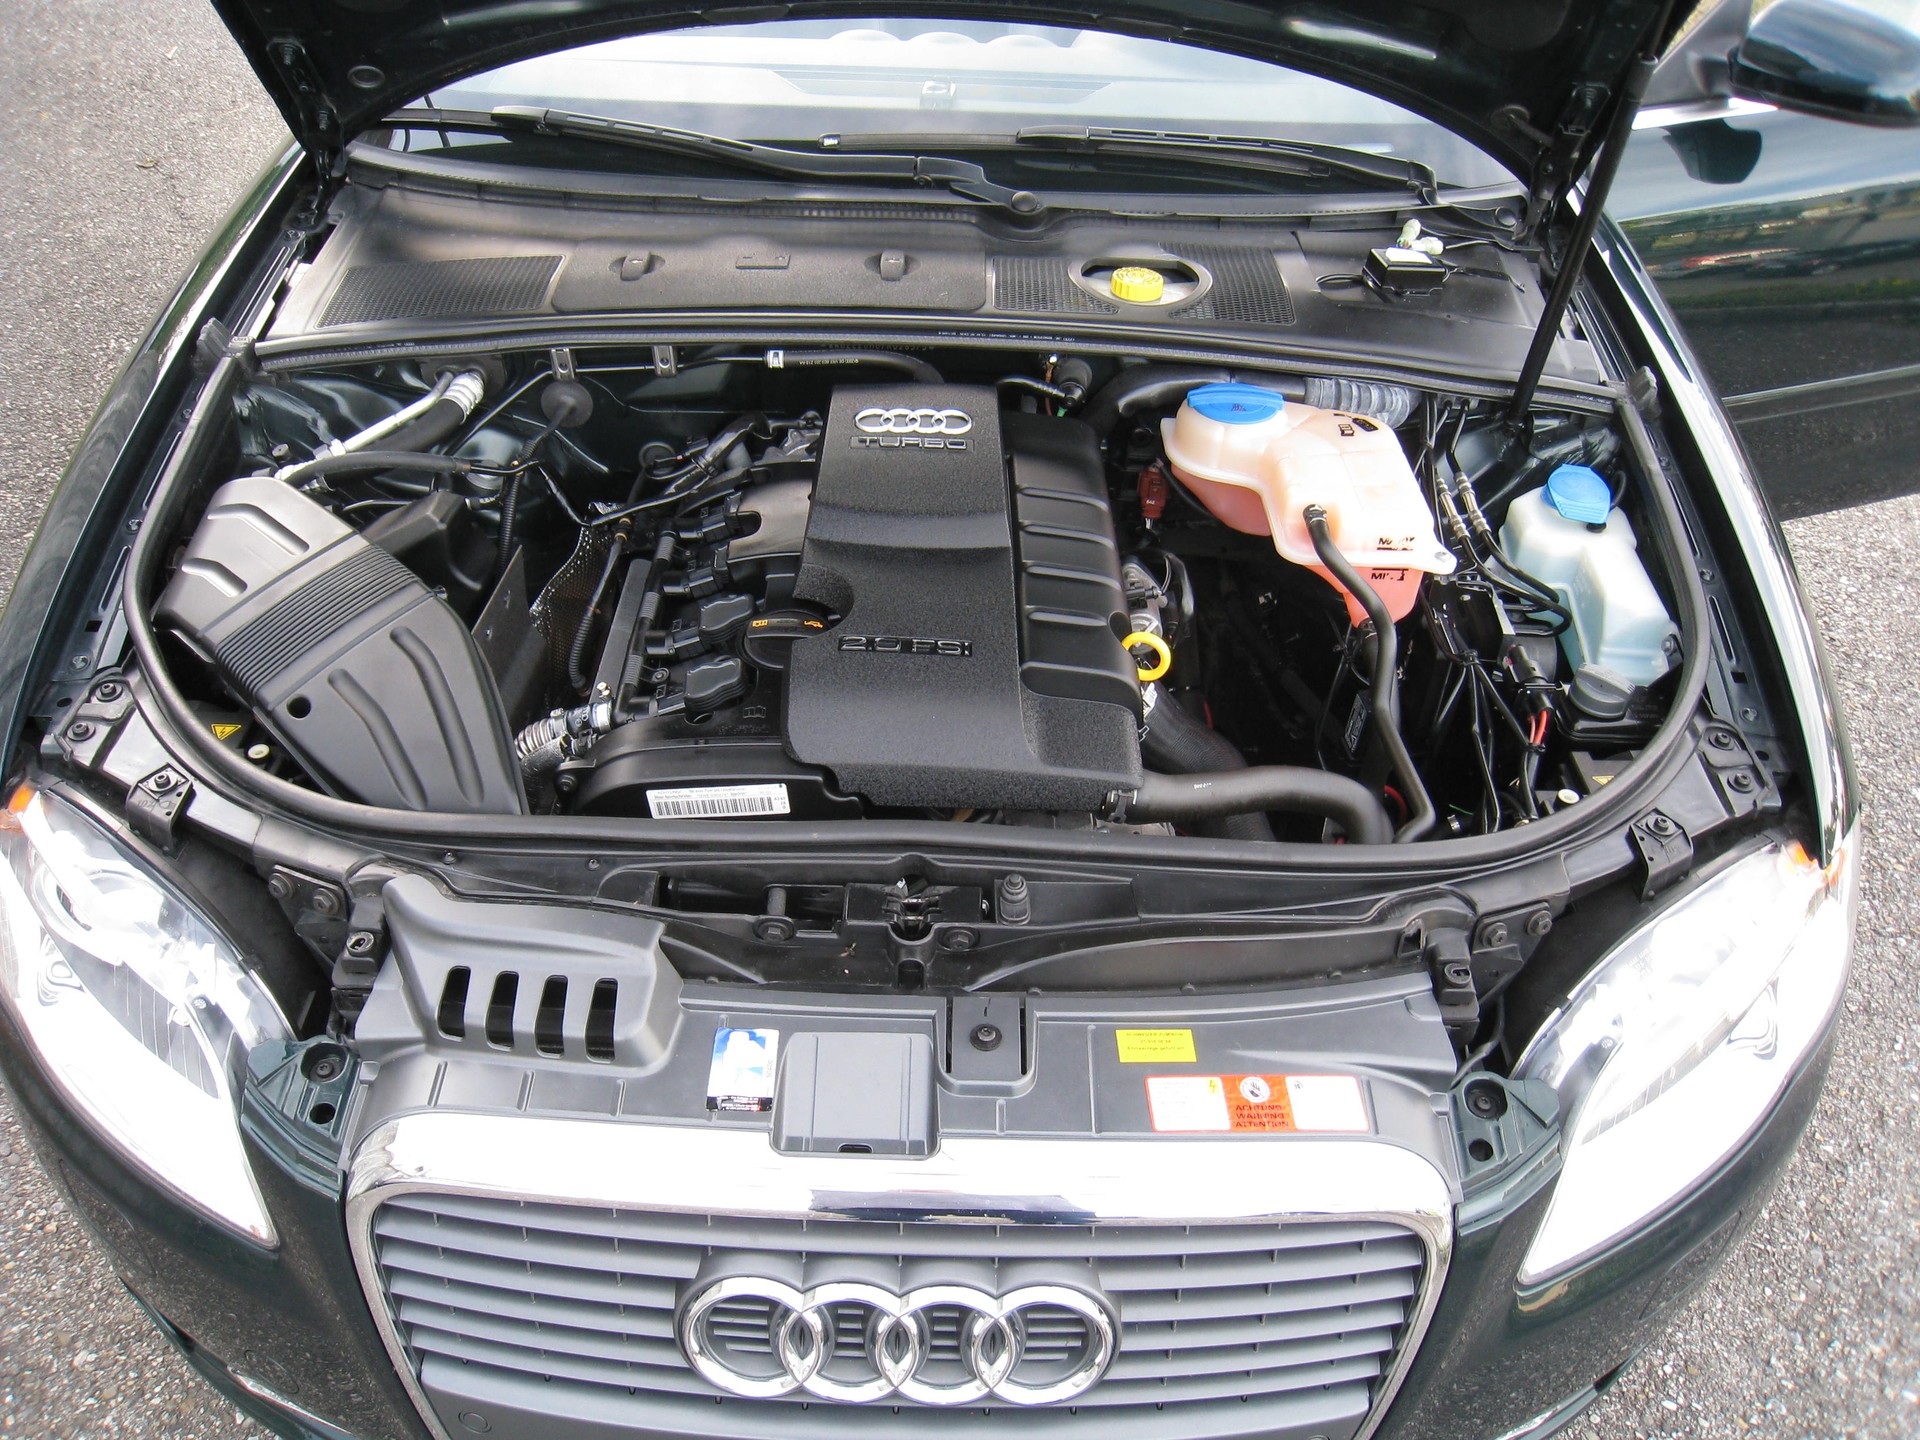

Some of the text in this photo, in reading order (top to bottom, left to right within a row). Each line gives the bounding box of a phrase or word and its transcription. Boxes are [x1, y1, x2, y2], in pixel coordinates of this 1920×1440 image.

[857, 436, 967, 450] TURBO
[840, 636, 970, 656] 2.0 FSI
